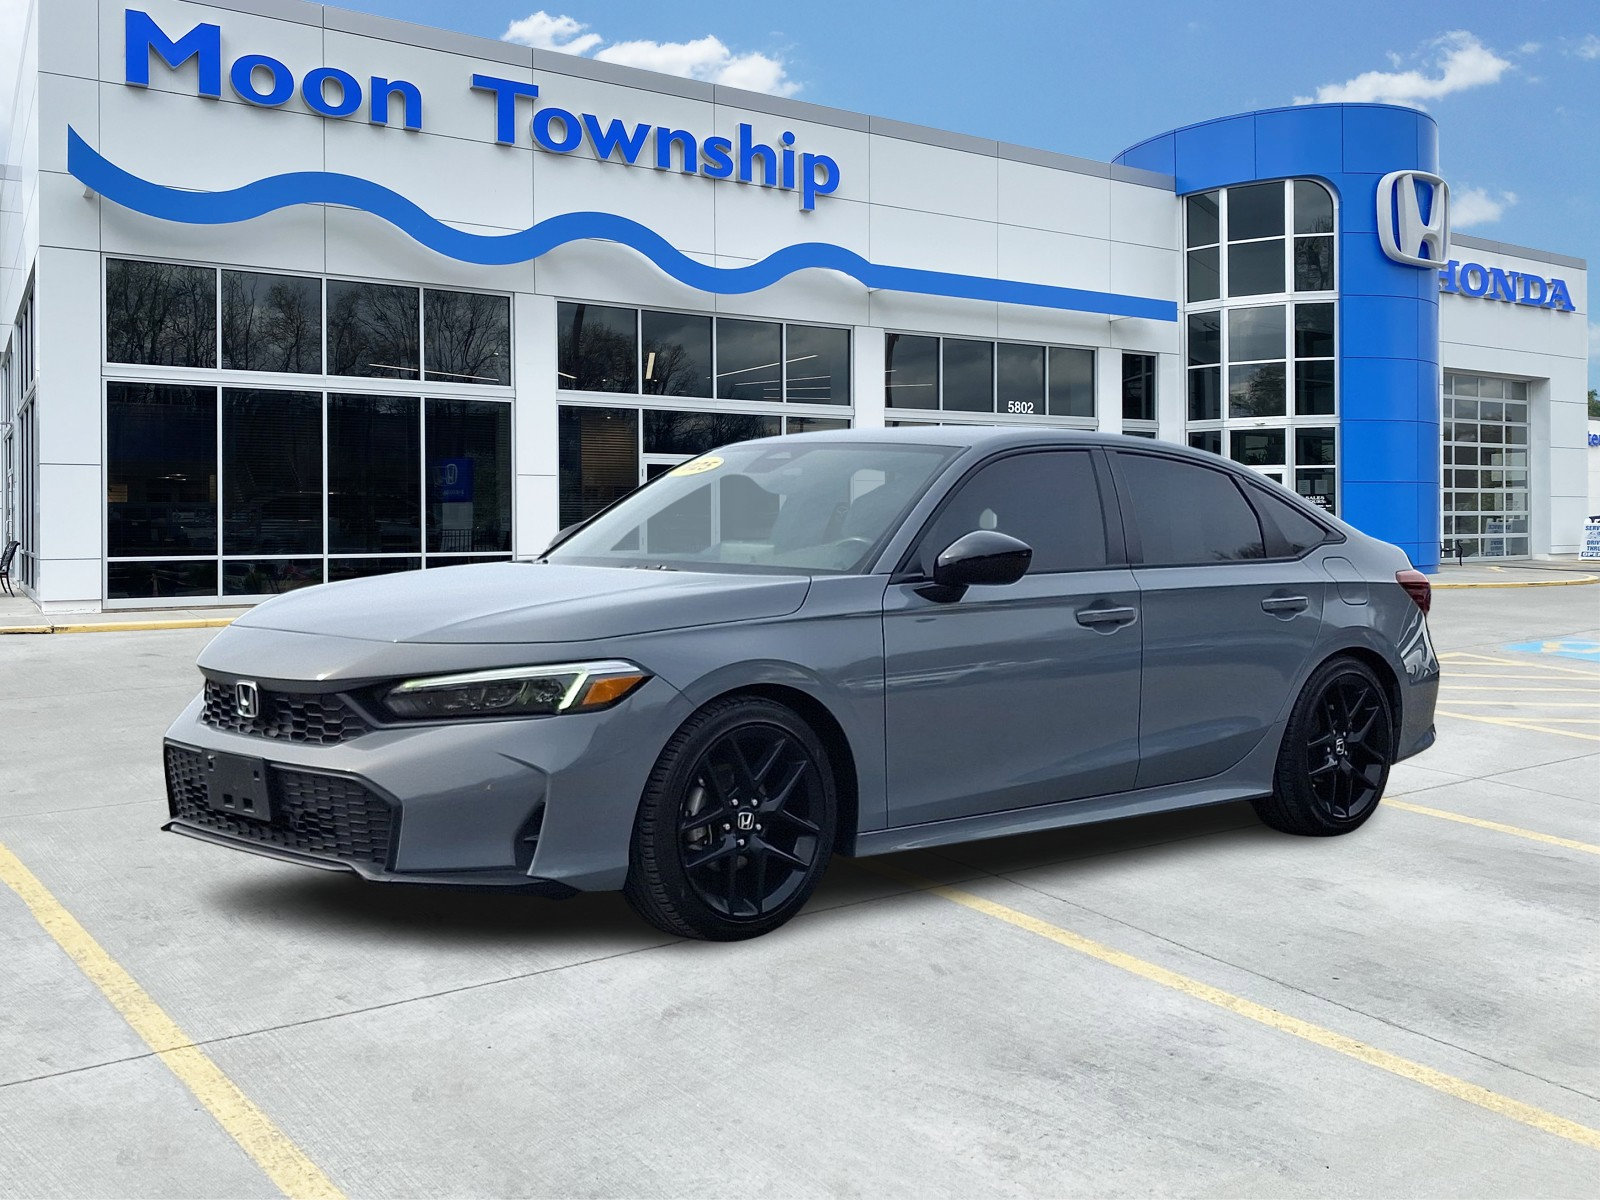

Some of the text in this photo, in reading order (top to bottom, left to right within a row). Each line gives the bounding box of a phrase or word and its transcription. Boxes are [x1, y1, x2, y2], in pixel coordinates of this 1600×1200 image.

[125, 8, 841, 212] Moon Township
[1438, 259, 1576, 312] HONDA
[1007, 400, 1034, 414] 5802
